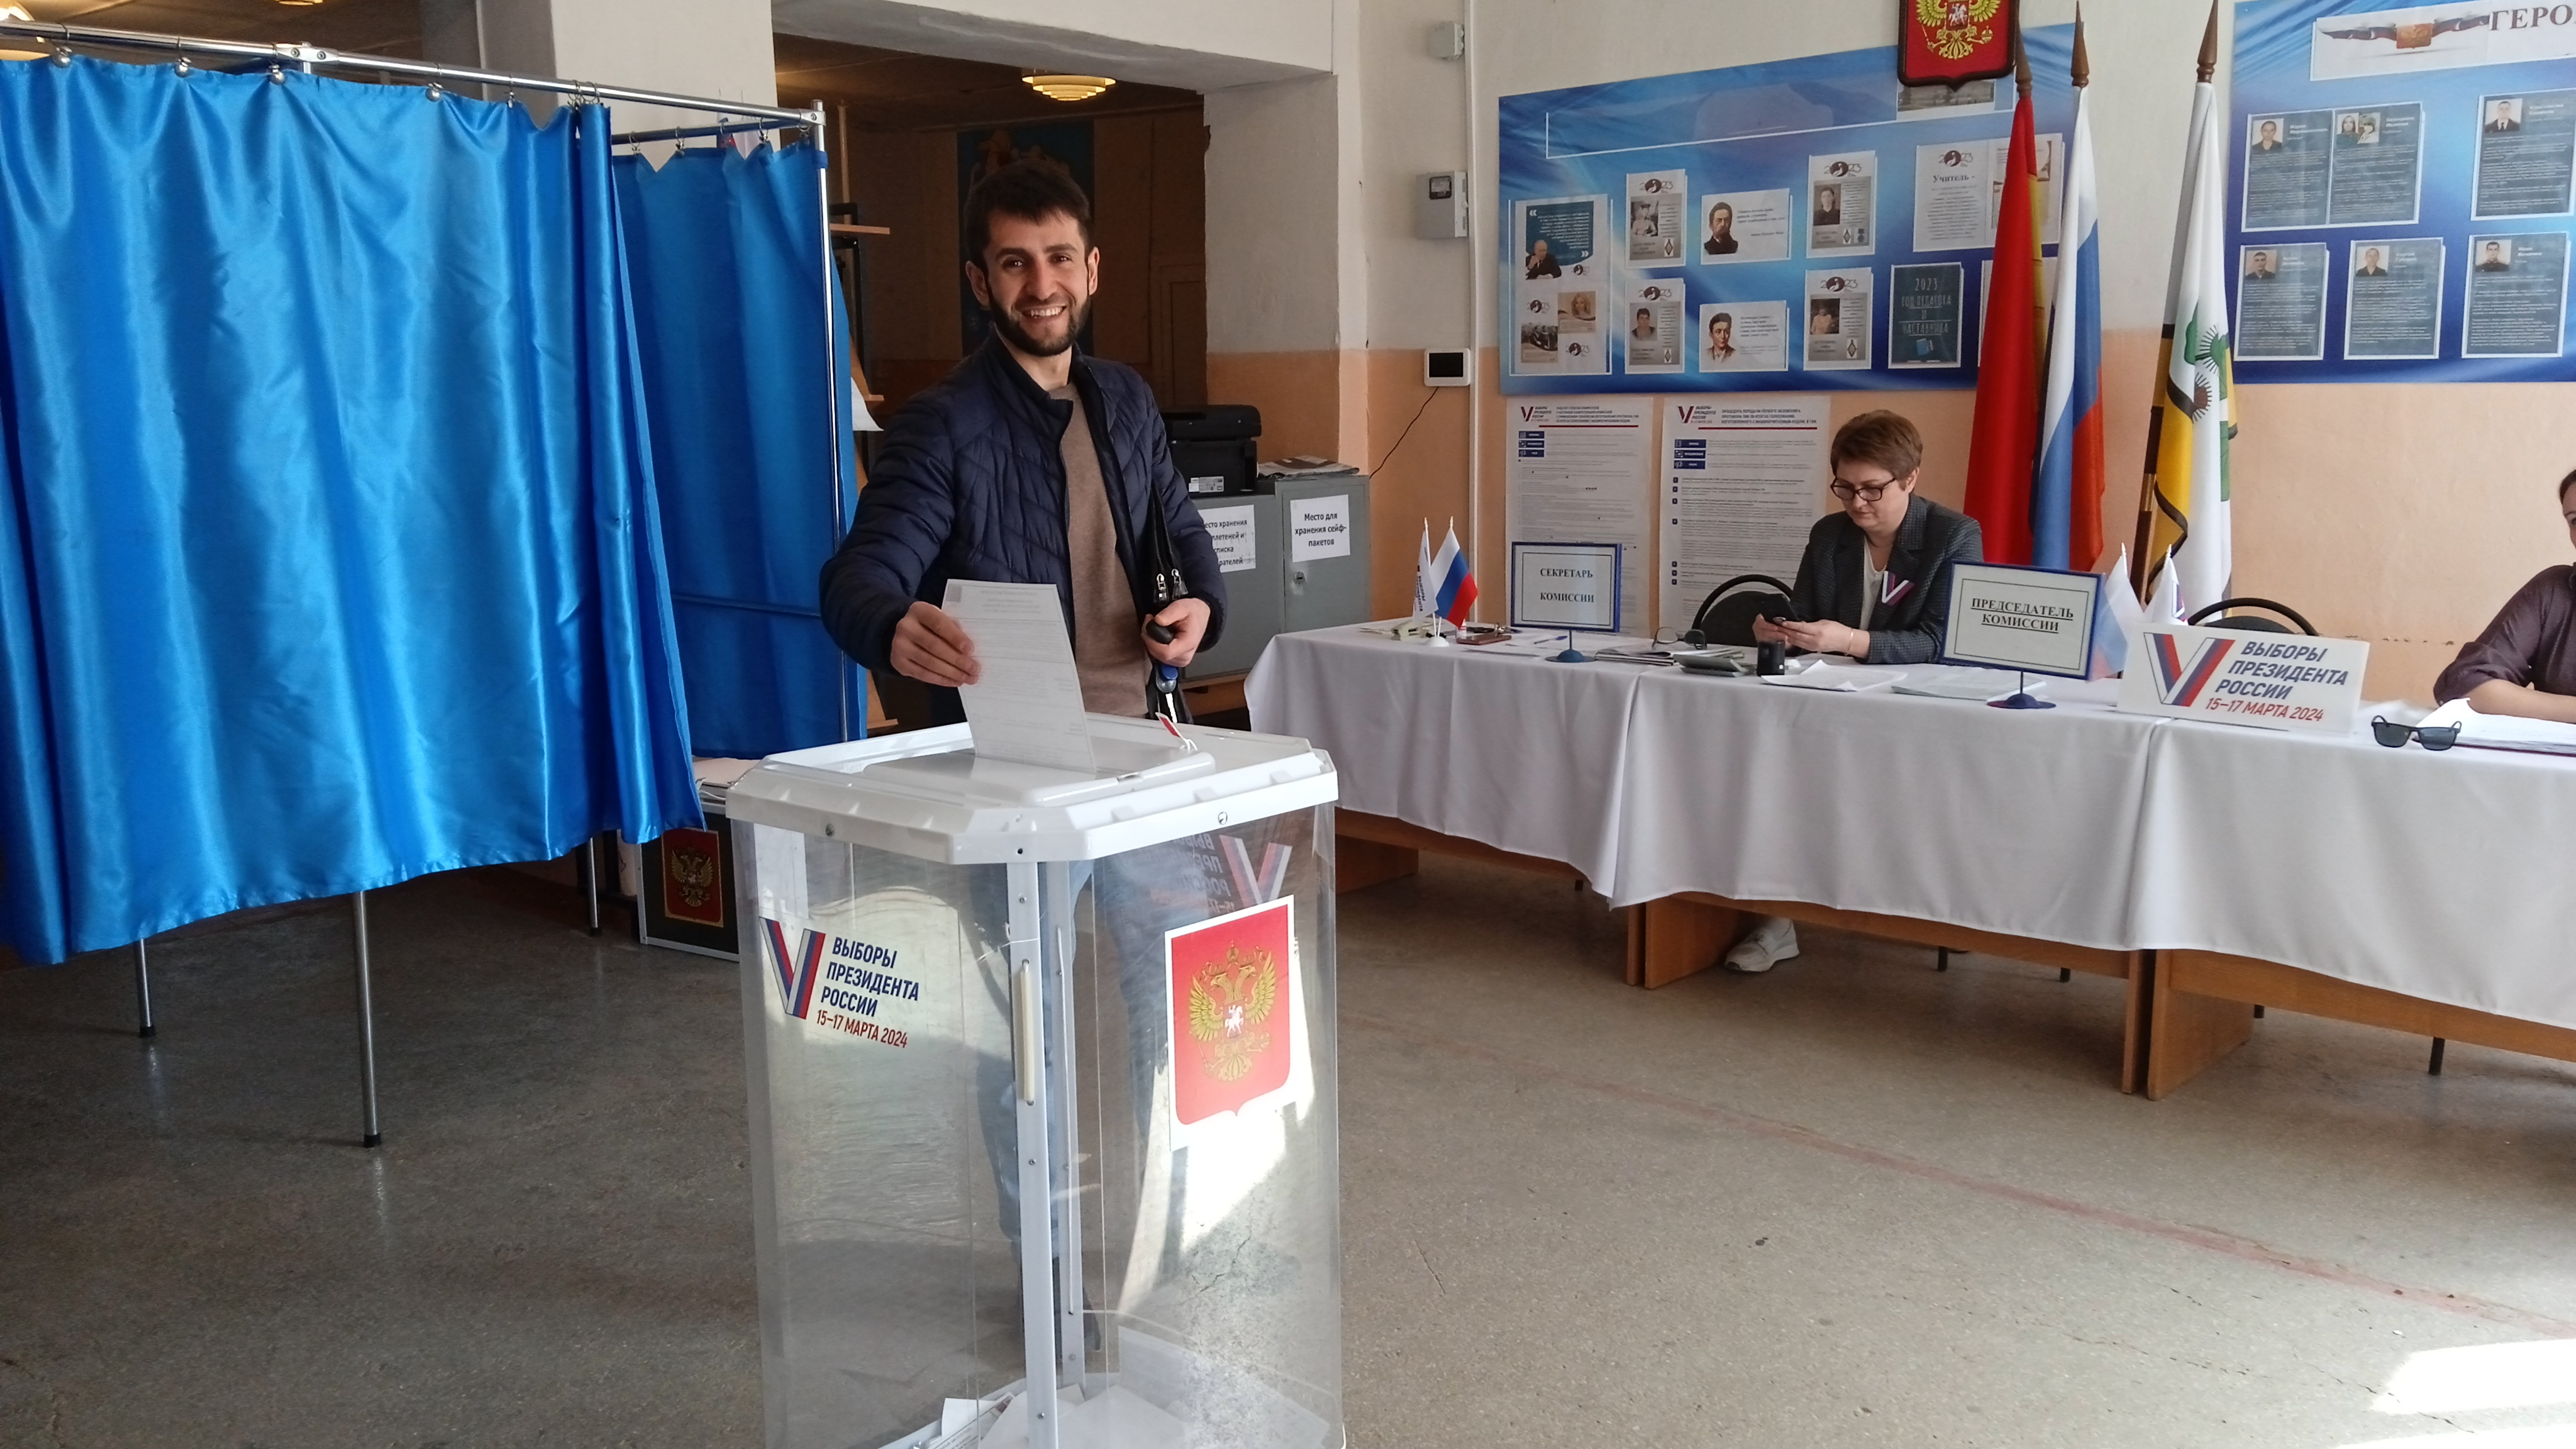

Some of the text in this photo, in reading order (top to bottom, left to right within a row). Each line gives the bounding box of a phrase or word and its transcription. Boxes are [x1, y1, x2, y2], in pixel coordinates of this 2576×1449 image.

[2490, 4, 2576, 31] ГЕРО
[1915, 277, 1937, 291] 2023
[1219, 519, 1247, 528] хранения
[1325, 513, 1337, 521] для
[1295, 524, 1346, 536] хранения сейф-
[1219, 557, 1243, 566] рателей
[1540, 568, 1593, 578] СЕКРЕТАРЬ
[1540, 592, 1594, 602] КОМИССИИ
[1971, 598, 2074, 619] ПРЕДСЕДАТЕЛЬ
[1982, 613, 2059, 631] КОМИССИИ
[2240, 641, 2328, 662] ВЫБОРЫ
[2228, 660, 2349, 686] ПРЕЗИДЕНТА
[2215, 679, 2294, 699] РОССИИ
[2241, 701, 2290, 718] МАРТА
[2289, 706, 2324, 721] 2024
[832, 936, 897, 969] ВЫБОРЫ
[826, 961, 919, 1001] ПРЕЗИДЕНТА
[821, 985, 878, 1018] РОССИИ
[844, 1017, 879, 1041] МАРТА
[880, 1028, 908, 1048] 2024
